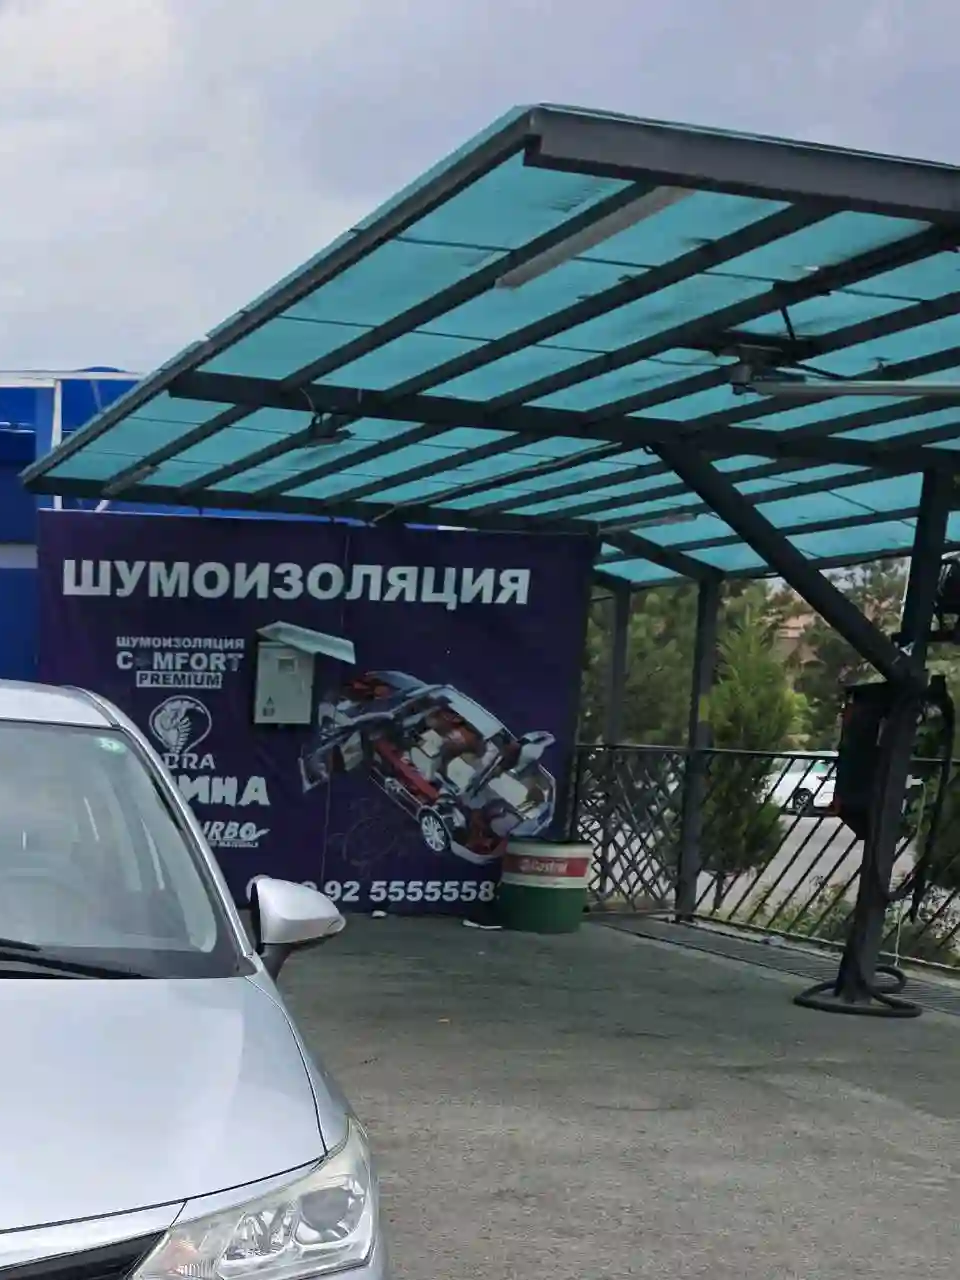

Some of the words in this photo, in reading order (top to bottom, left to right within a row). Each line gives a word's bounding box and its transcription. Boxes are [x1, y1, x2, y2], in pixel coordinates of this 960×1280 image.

[63, 559, 531, 610] ШУМОИЗОЛЯЦИЯ
[116, 636, 245, 650] ШУМОИЗОЛЯЦИЯ
[116, 651, 244, 671] CMFORT
[139, 672, 221, 687] PREMIUM
[162, 752, 216, 770] BRA
[368, 880, 495, 902] 5555558
